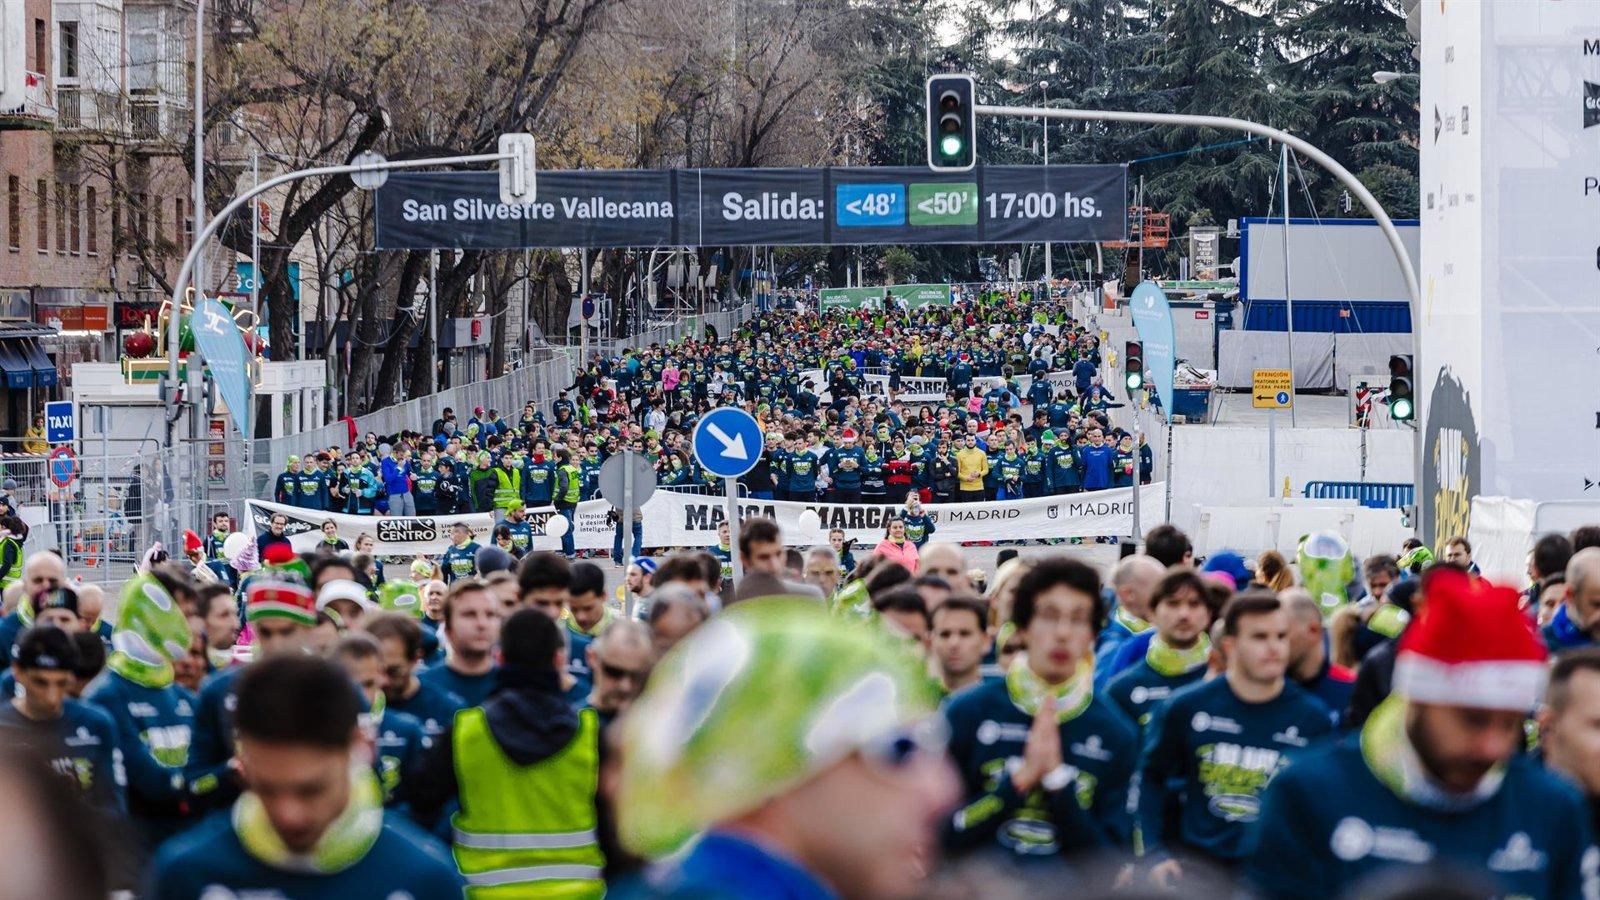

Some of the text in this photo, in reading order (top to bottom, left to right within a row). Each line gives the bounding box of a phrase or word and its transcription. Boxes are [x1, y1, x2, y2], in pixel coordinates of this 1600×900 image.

[403, 197, 674, 221] San Silvestre Vallecana
[722, 191, 1102, 221] Salida: <48' <50' 17:00 hs.
[49, 415, 72, 429] TAXI
[528, 514, 550, 524] ANI
[950, 509, 1021, 521] MADRID
[380, 520, 412, 530] SANI
[380, 530, 435, 541] CENTRO
